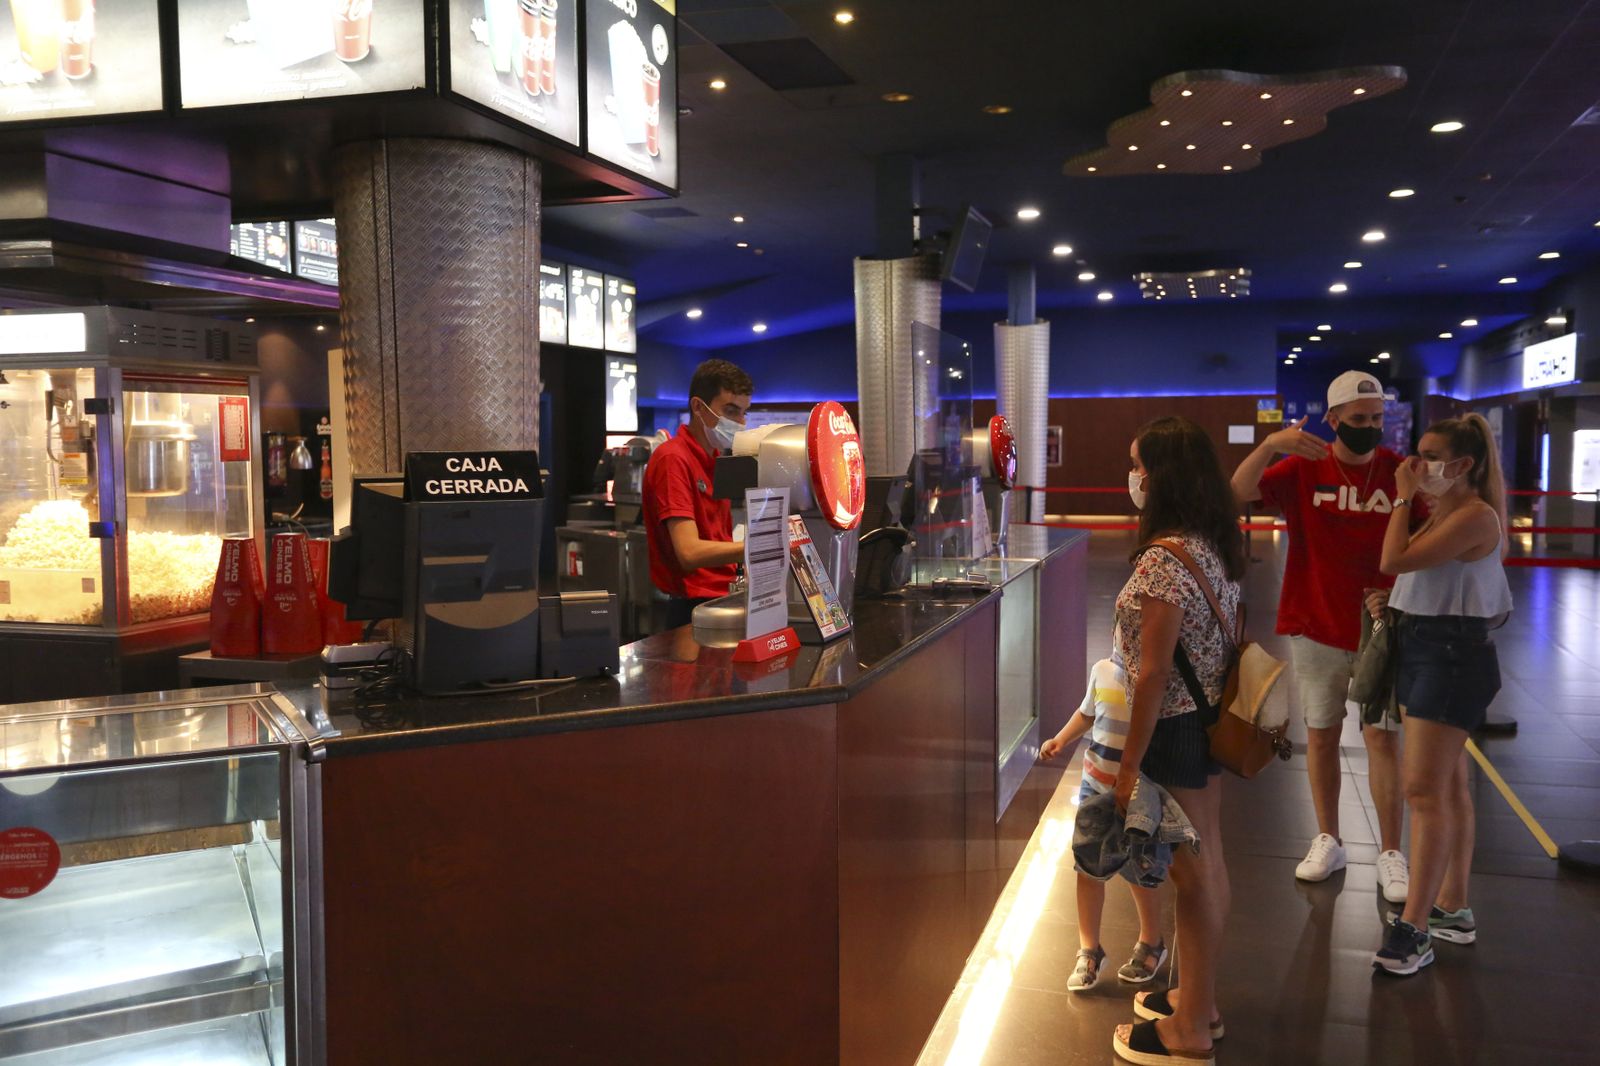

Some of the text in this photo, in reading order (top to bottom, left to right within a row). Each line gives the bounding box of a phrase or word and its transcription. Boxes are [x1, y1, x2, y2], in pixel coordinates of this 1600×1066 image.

[446, 457, 503, 472] CAJA
[425, 478, 530, 495] CERRADA
[1312, 484, 1392, 514] FILA
[231, 541, 240, 582] YELMO
[284, 537, 293, 584] YELMO
